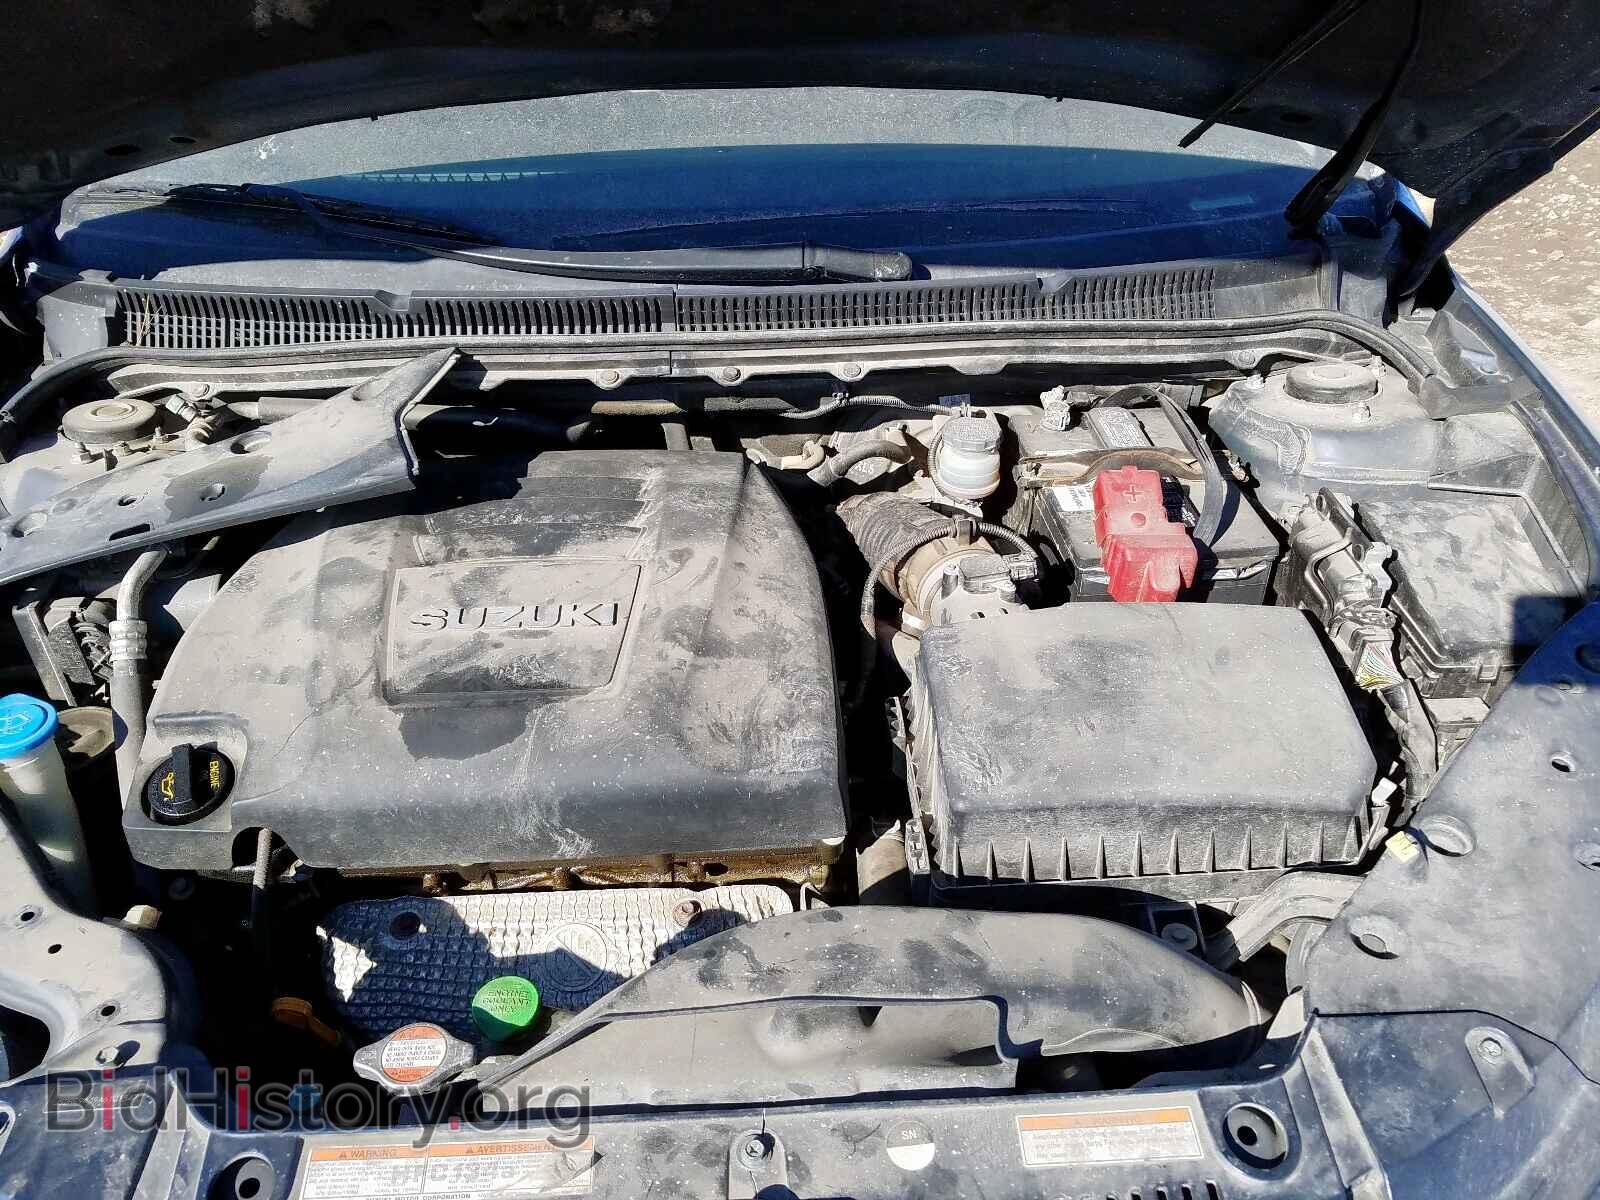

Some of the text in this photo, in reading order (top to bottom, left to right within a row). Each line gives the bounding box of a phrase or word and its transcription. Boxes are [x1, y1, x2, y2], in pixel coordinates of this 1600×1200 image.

[409, 602, 618, 633] SUZUKI
[209, 760, 221, 790] ENGINE
[902, 1128, 918, 1140] SN
[350, 1148, 398, 1159] WARNING
